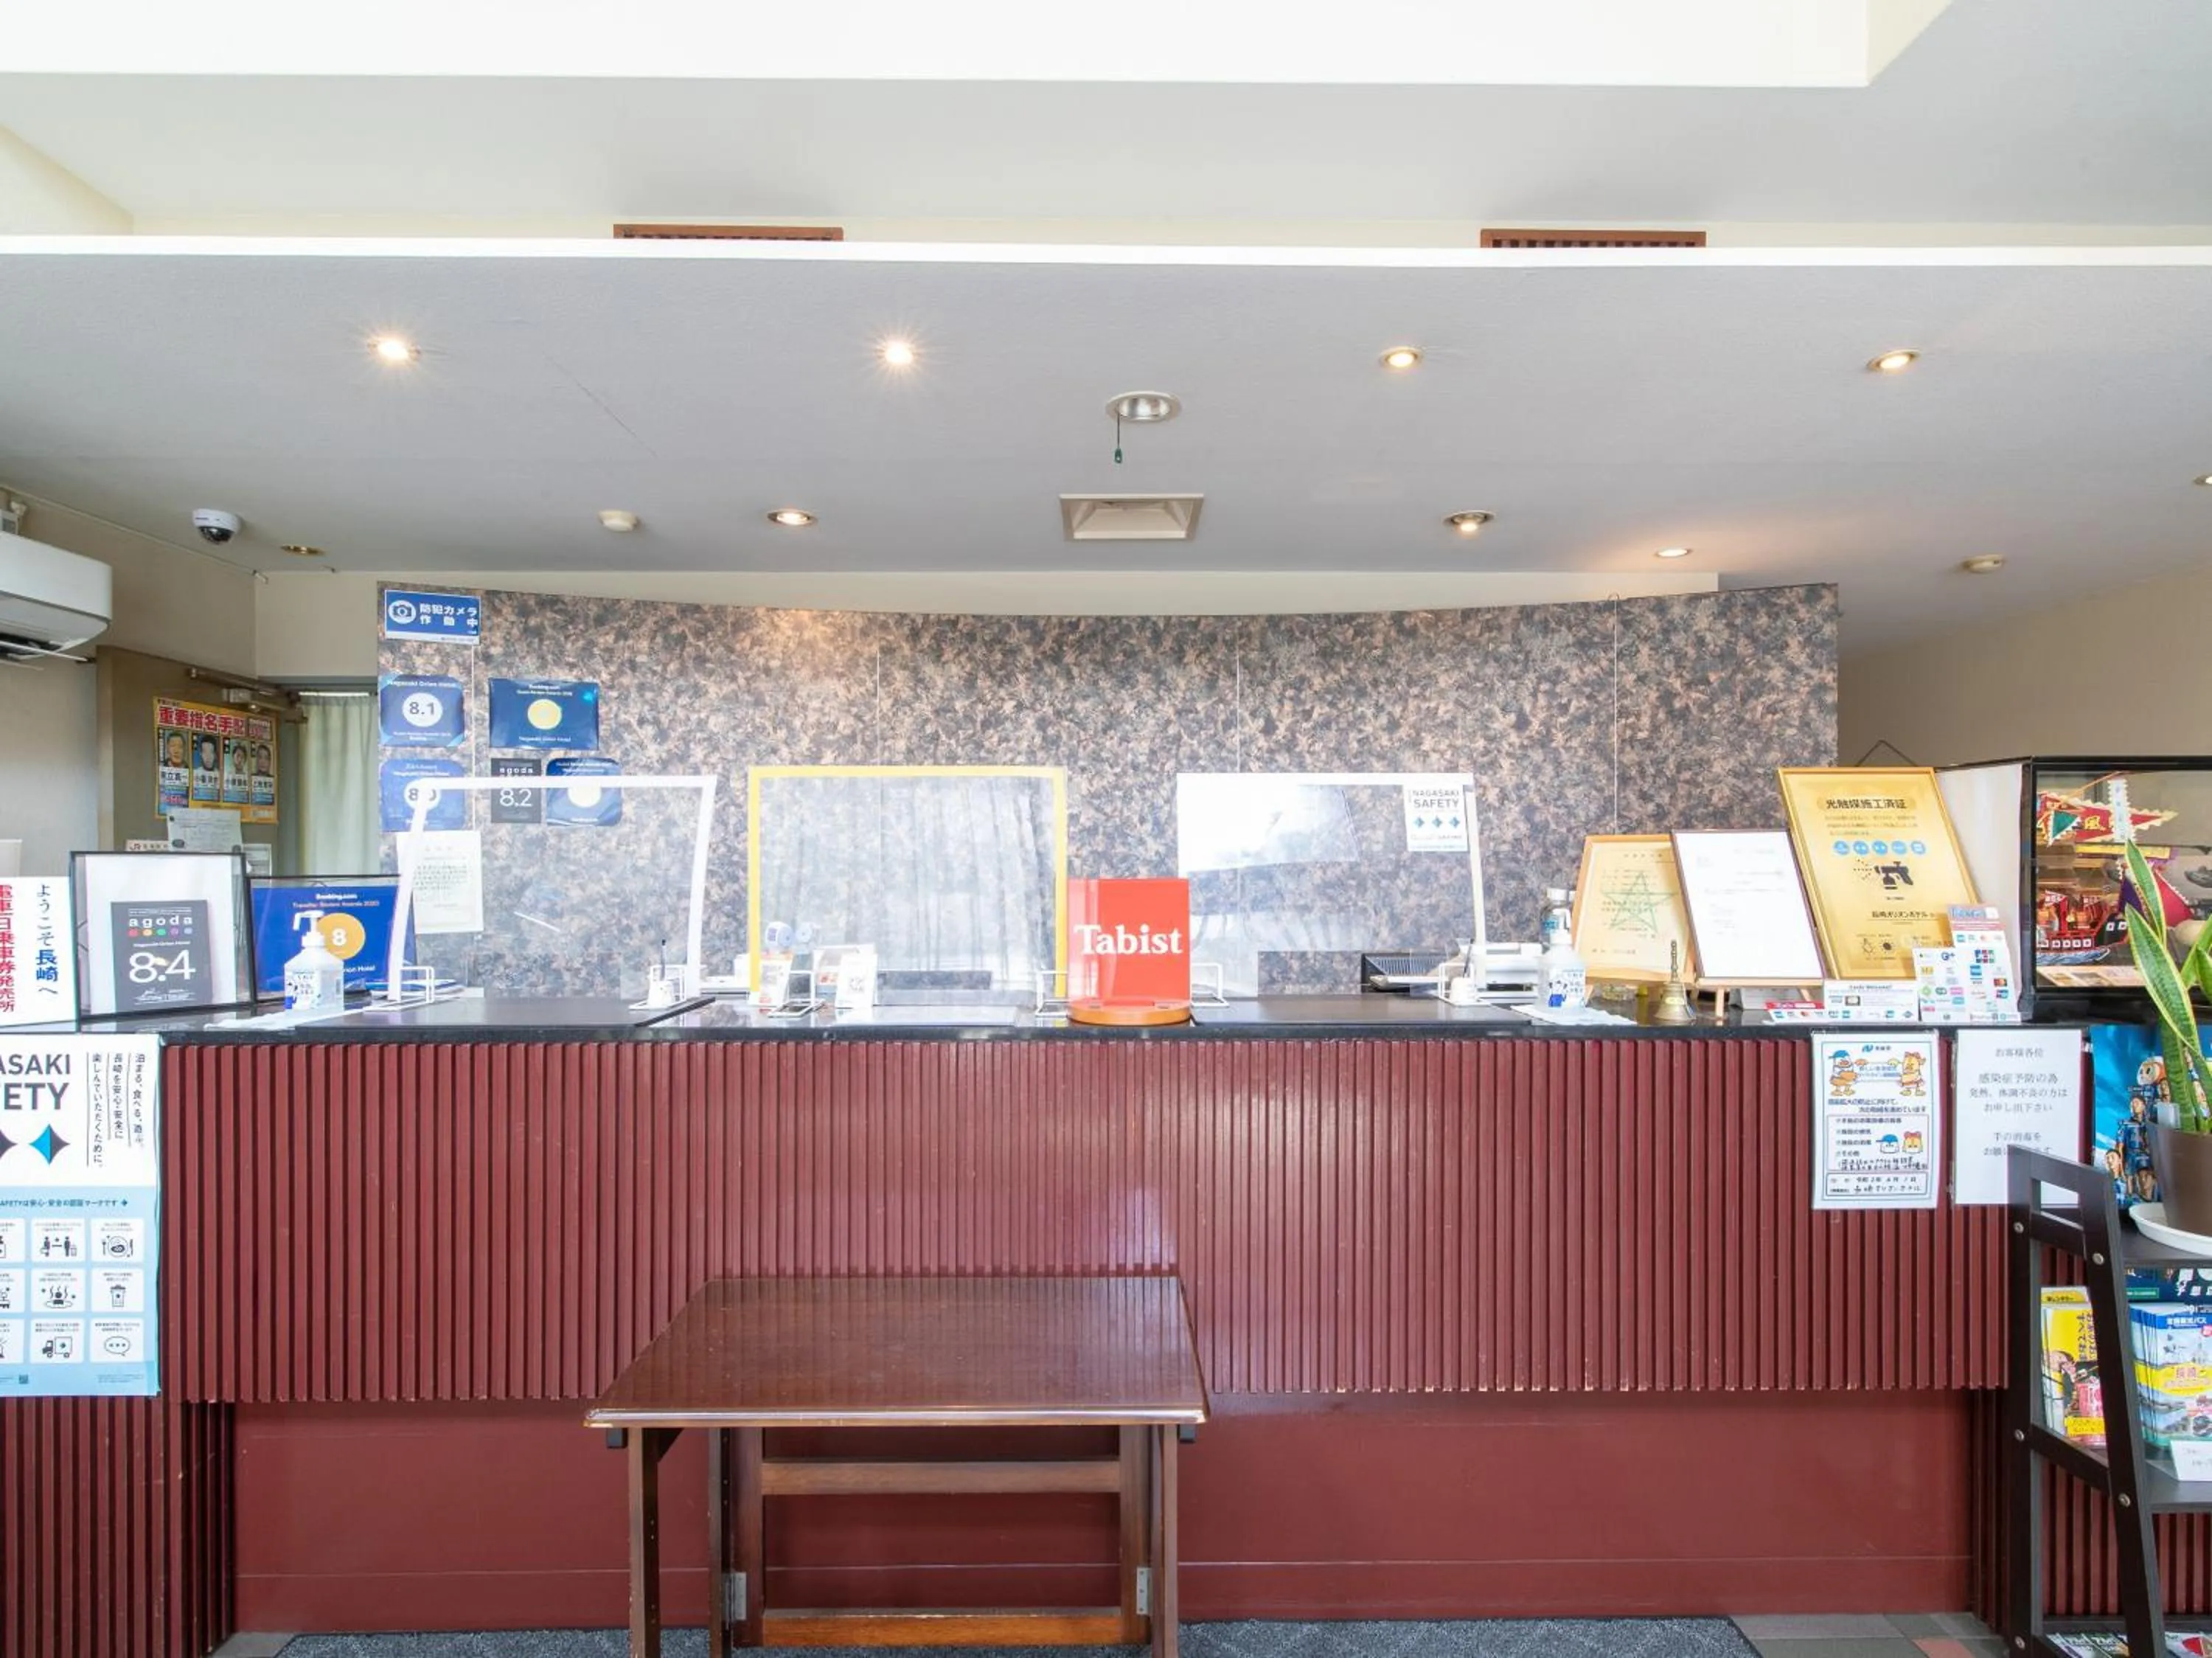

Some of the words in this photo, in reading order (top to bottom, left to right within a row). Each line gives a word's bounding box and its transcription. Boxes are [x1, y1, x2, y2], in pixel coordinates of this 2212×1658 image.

[419, 603, 478, 617] 防犯カメラ
[409, 701, 434, 715] 8.1
[499, 788, 532, 807] 8.2
[1413, 799, 1459, 808] SAFETY
[129, 915, 192, 928] agoda
[35, 884, 58, 995] ようこそ長崎へ
[333, 928, 347, 946] 8
[1074, 923, 1183, 954] Tabist
[129, 949, 197, 983] 8.4
